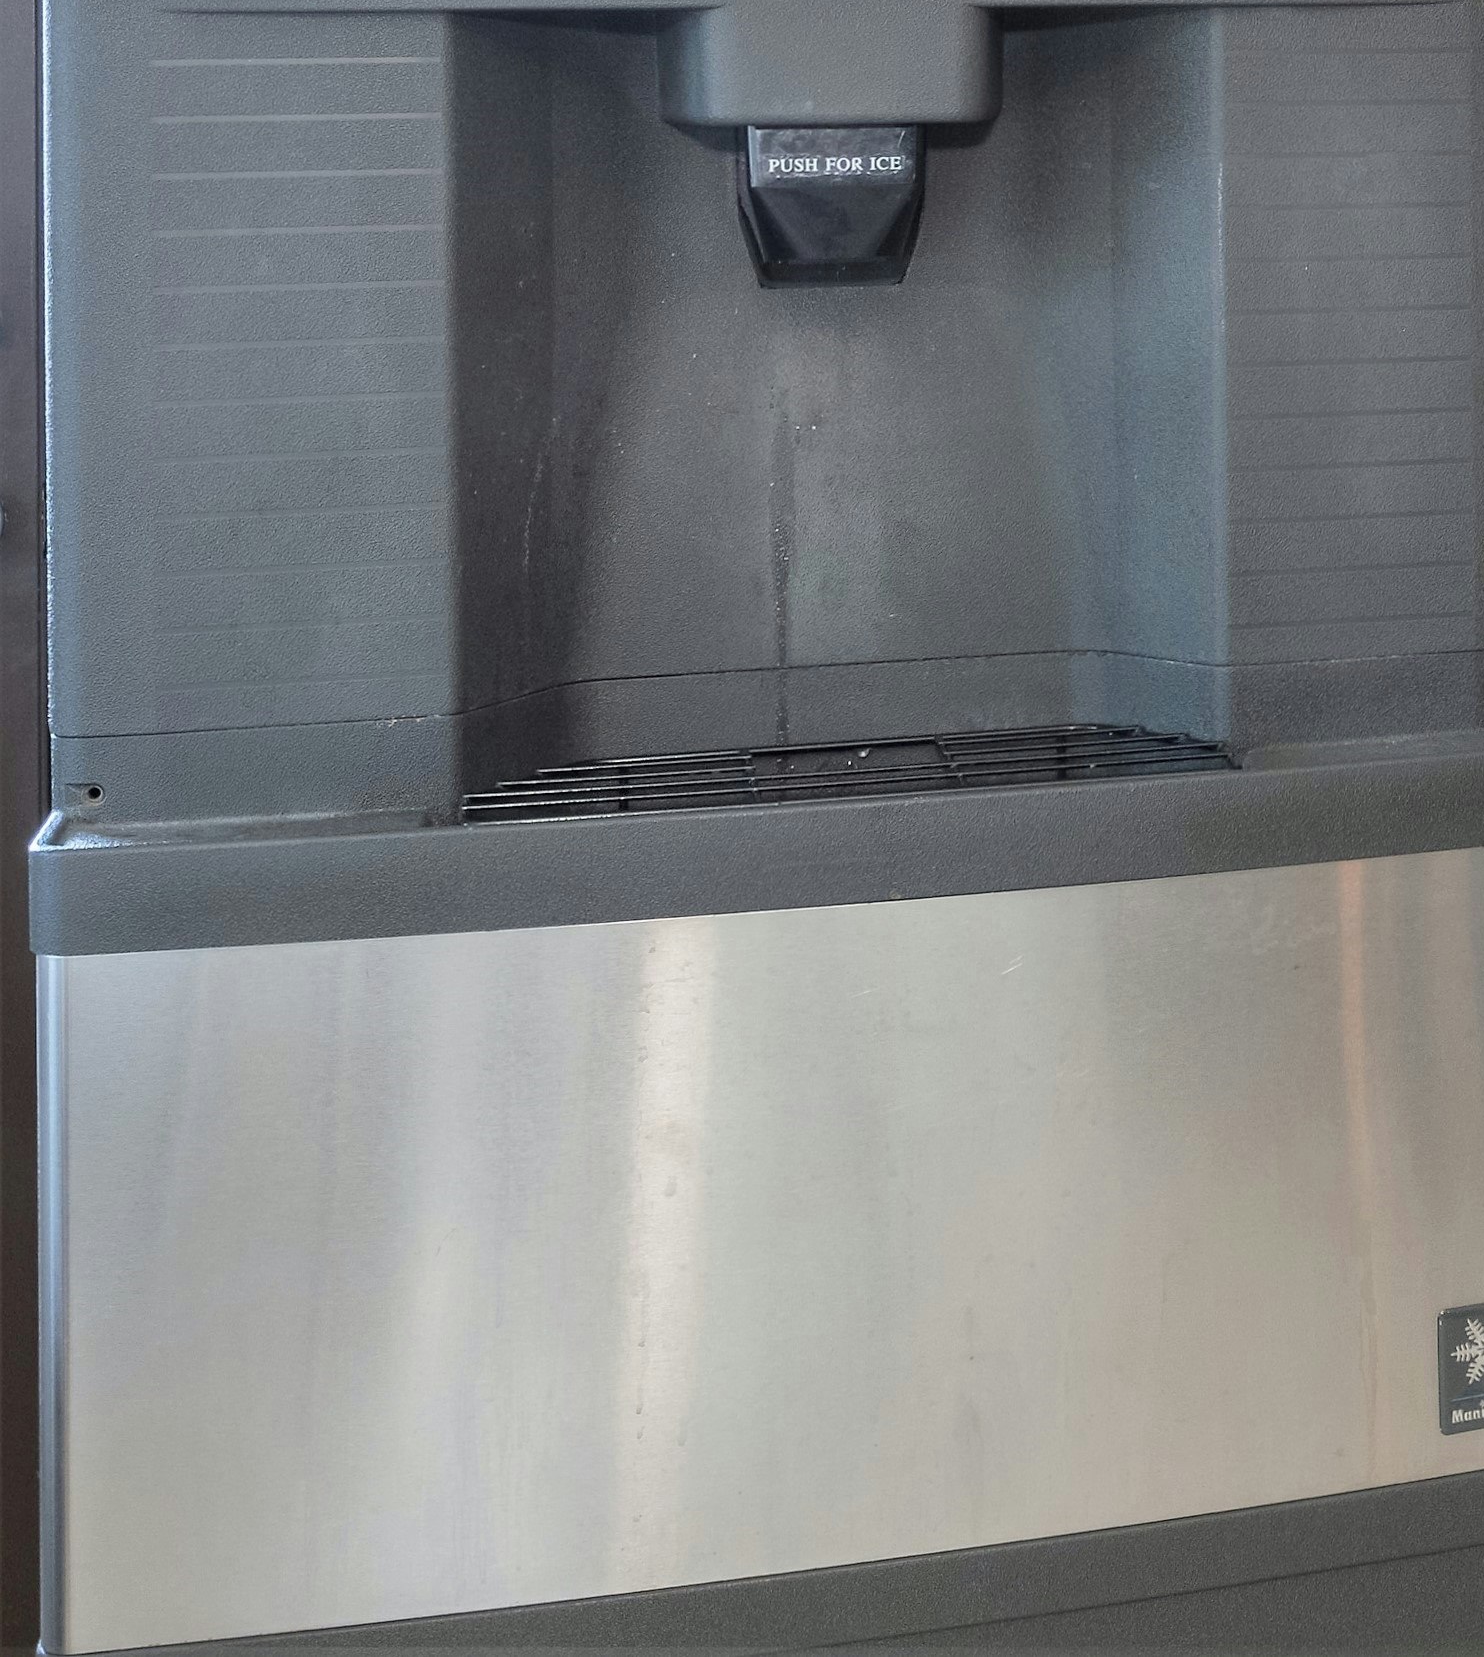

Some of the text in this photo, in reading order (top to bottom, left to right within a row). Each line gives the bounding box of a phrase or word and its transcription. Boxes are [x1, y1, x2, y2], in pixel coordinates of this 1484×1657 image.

[769, 156, 902, 173] PUSH FOR ICE
